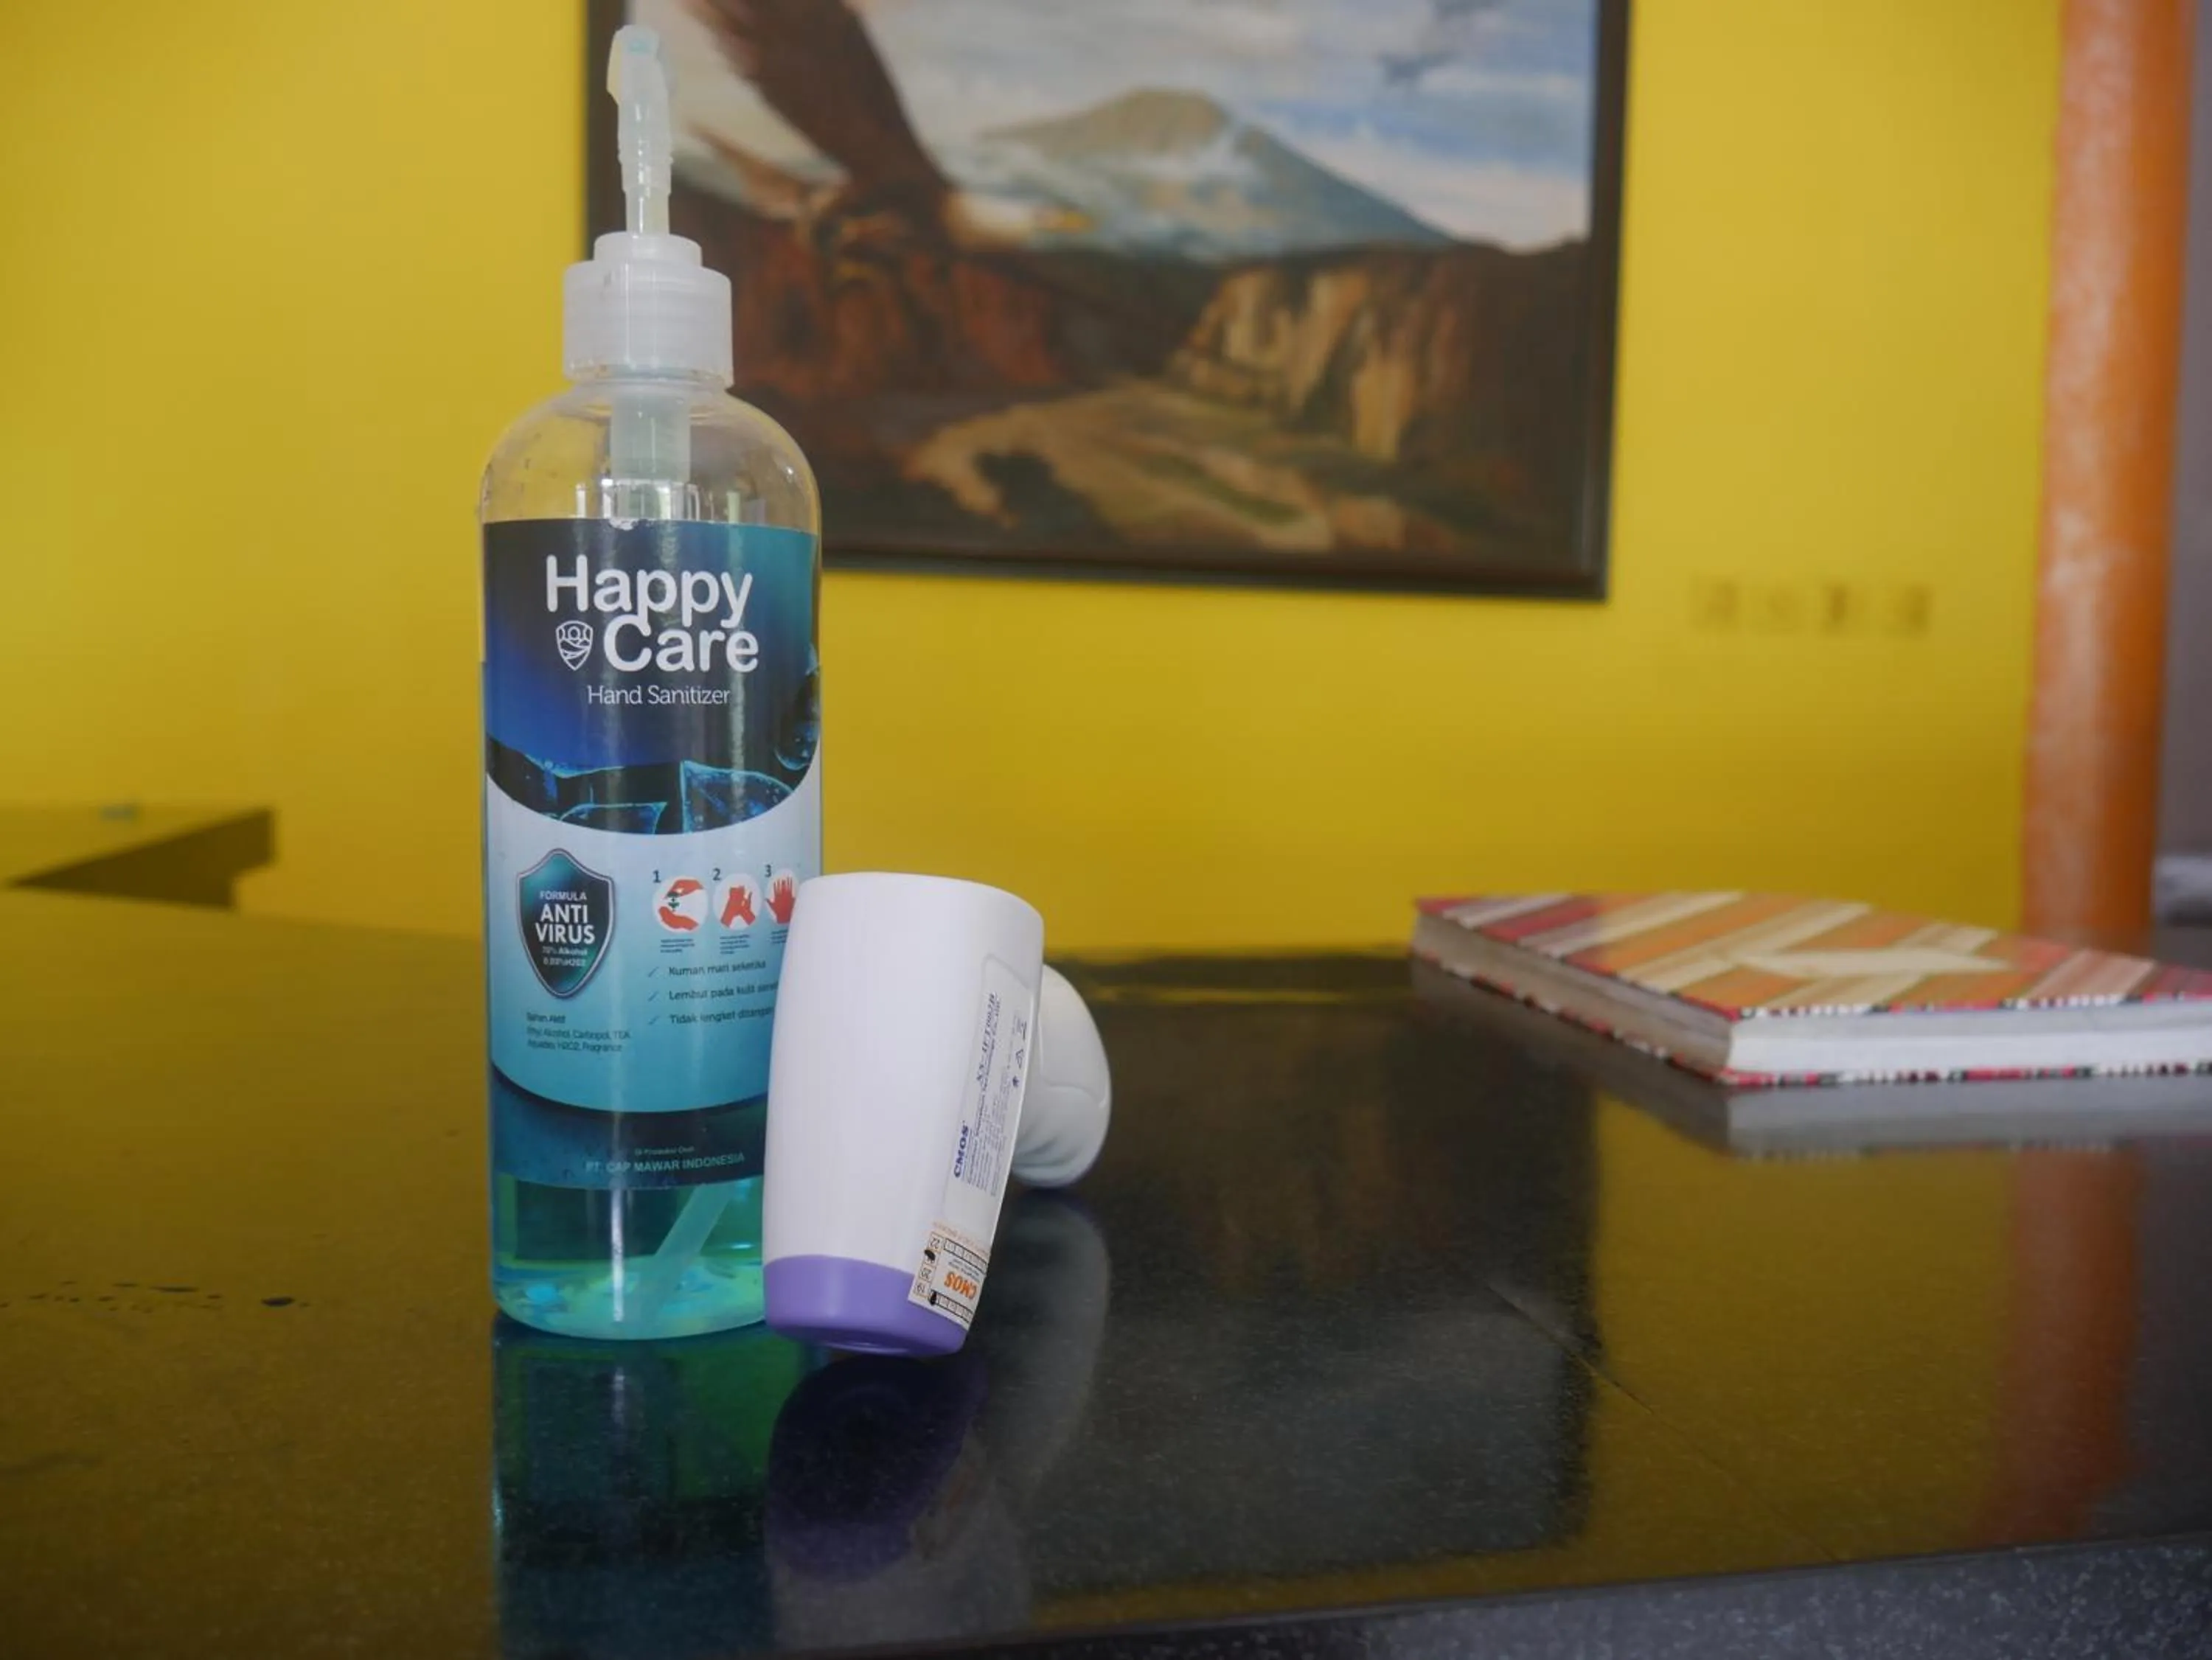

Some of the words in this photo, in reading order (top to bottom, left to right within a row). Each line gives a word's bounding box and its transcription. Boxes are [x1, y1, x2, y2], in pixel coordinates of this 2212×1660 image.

[546, 554, 753, 628] Happy
[604, 614, 759, 672] Care
[588, 686, 642, 705] Hand
[648, 686, 730, 705] Sanitizer
[653, 870, 661, 883] 1
[713, 868, 722, 881] 2
[765, 865, 772, 877] 3
[539, 890, 587, 901] FORMULA
[540, 904, 588, 924] ANTI
[535, 923, 595, 944] VIRUS
[711, 987, 734, 1000] pada
[669, 1013, 697, 1025] Tidak
[954, 1124, 969, 1179] CMOS
[634, 1159, 680, 1173] MAWAR
[681, 1152, 745, 1169] INDONESIA
[945, 1272, 978, 1300] CMOS
